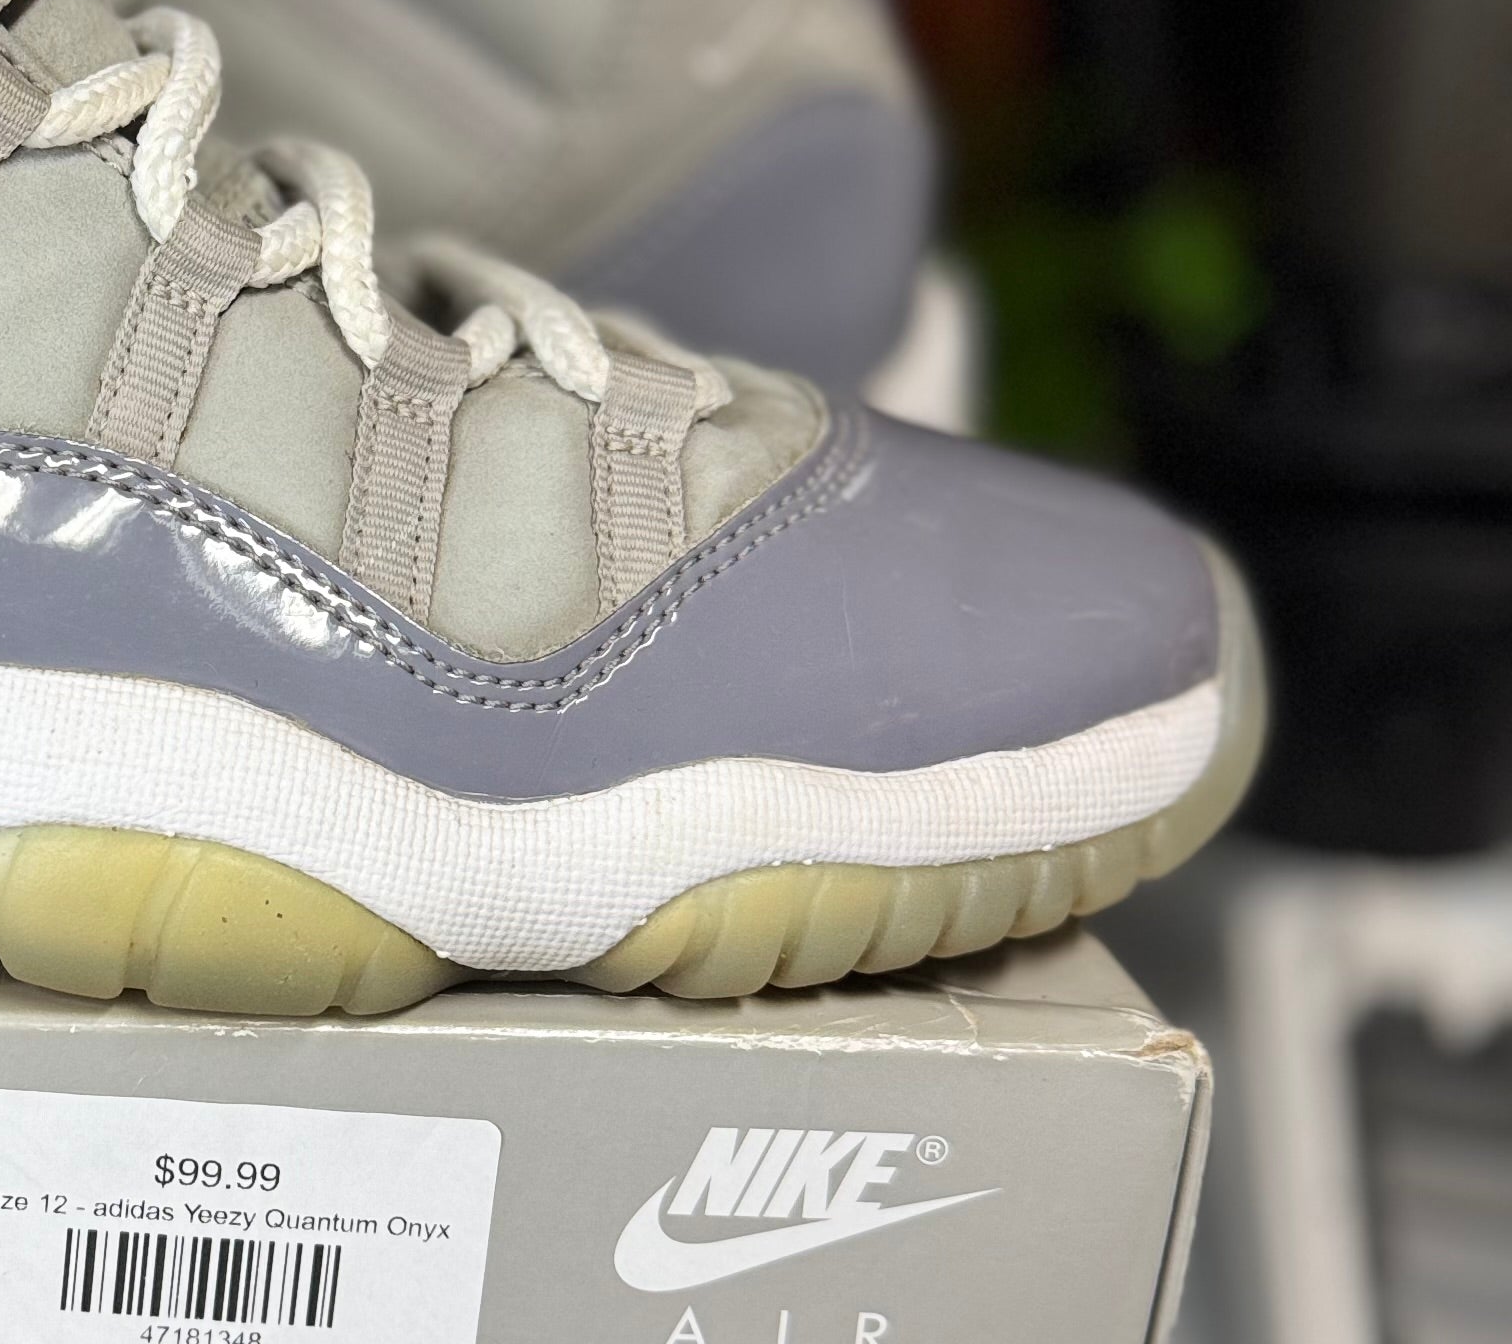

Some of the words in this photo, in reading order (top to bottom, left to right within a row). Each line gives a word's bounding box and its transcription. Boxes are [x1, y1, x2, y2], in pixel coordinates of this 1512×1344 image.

[153, 1152, 282, 1194] $99.99
[666, 1126, 916, 1220] NIKE
[40, 1193, 68, 1216] 12
[92, 1197, 175, 1223] adidas
[184, 1202, 257, 1232] Yeezy
[264, 1207, 378, 1236] Quantum
[386, 1215, 451, 1242] Onyx
